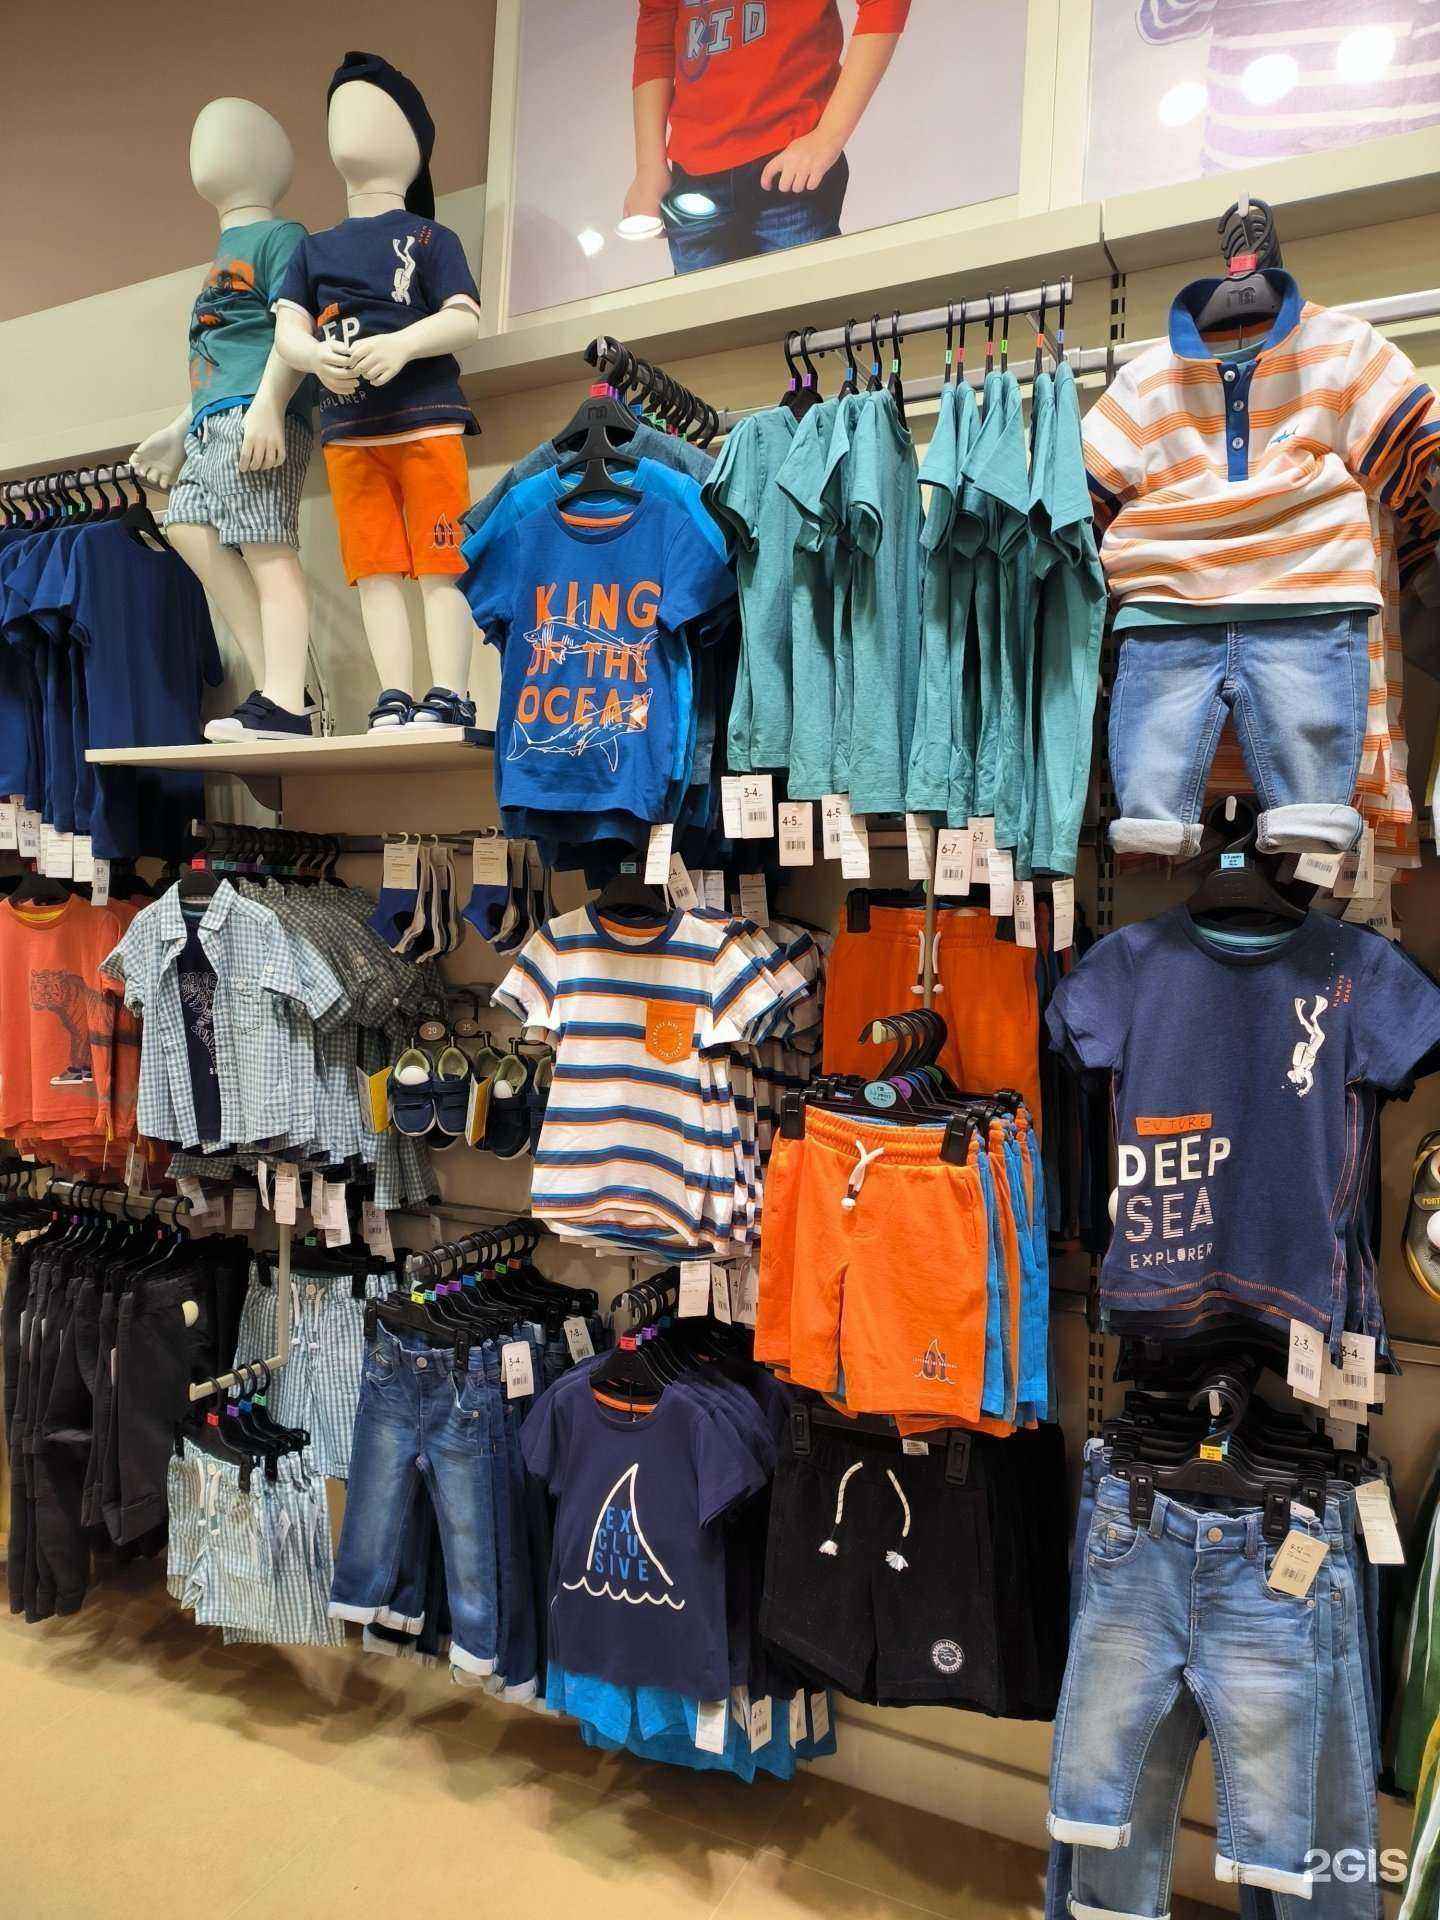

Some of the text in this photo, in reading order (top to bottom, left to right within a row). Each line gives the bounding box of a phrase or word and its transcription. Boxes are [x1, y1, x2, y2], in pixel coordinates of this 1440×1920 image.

[686, 7, 767, 59] KID
[535, 580, 661, 631] KING
[583, 641, 651, 683] THE
[517, 685, 648, 730] OCEAN
[1142, 1117, 1209, 1131] FUTURE
[1118, 1134, 1231, 1187] DEEP
[1124, 1186, 1215, 1243] SEA
[1129, 1243, 1214, 1270] EXPLORER
[605, 1506, 632, 1534] EX
[597, 1528, 639, 1557] CLU
[594, 1551, 649, 1581] SIVE
